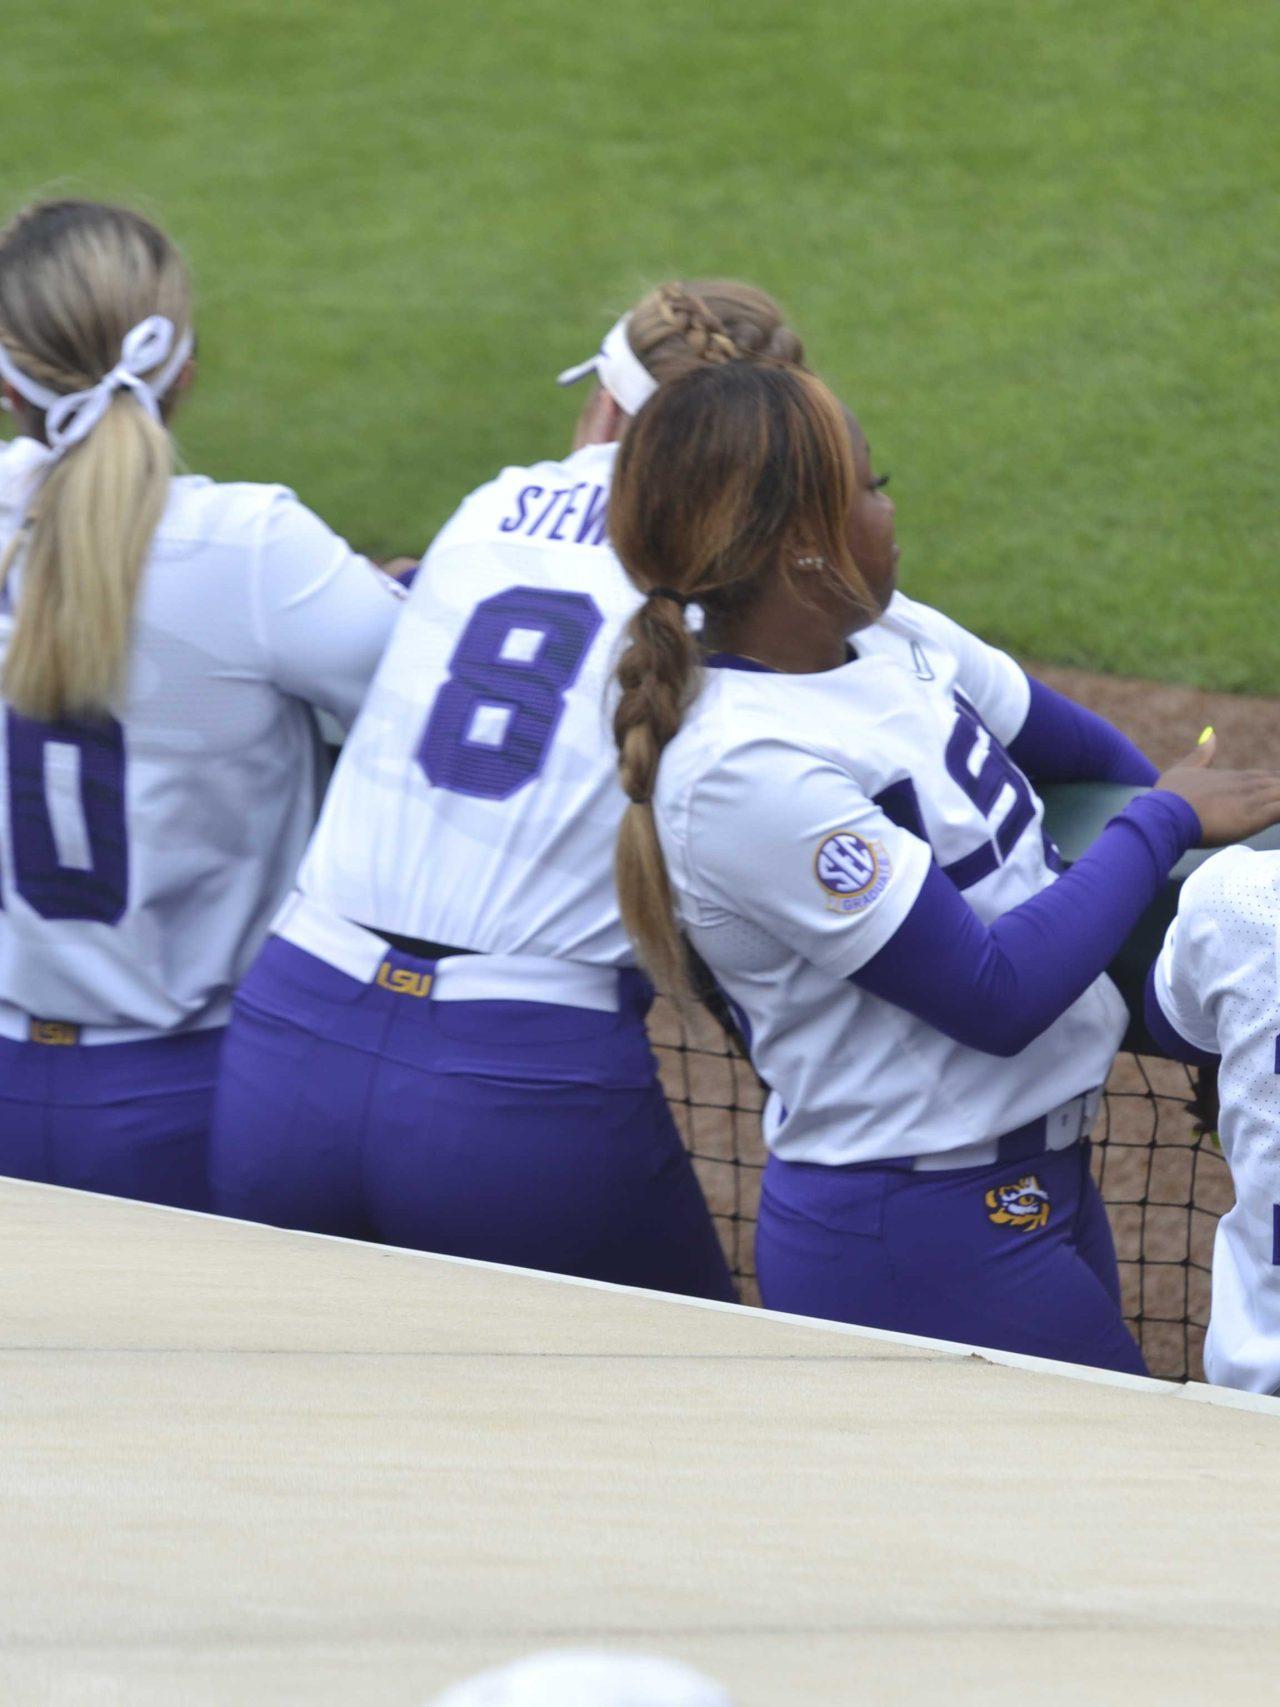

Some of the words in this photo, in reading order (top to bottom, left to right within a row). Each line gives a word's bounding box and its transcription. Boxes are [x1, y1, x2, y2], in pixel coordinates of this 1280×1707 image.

[415, 585, 604, 802] 8
[7, 706, 129, 926] 0
[819, 834, 874, 892] SEC
[377, 962, 433, 998] LSU
